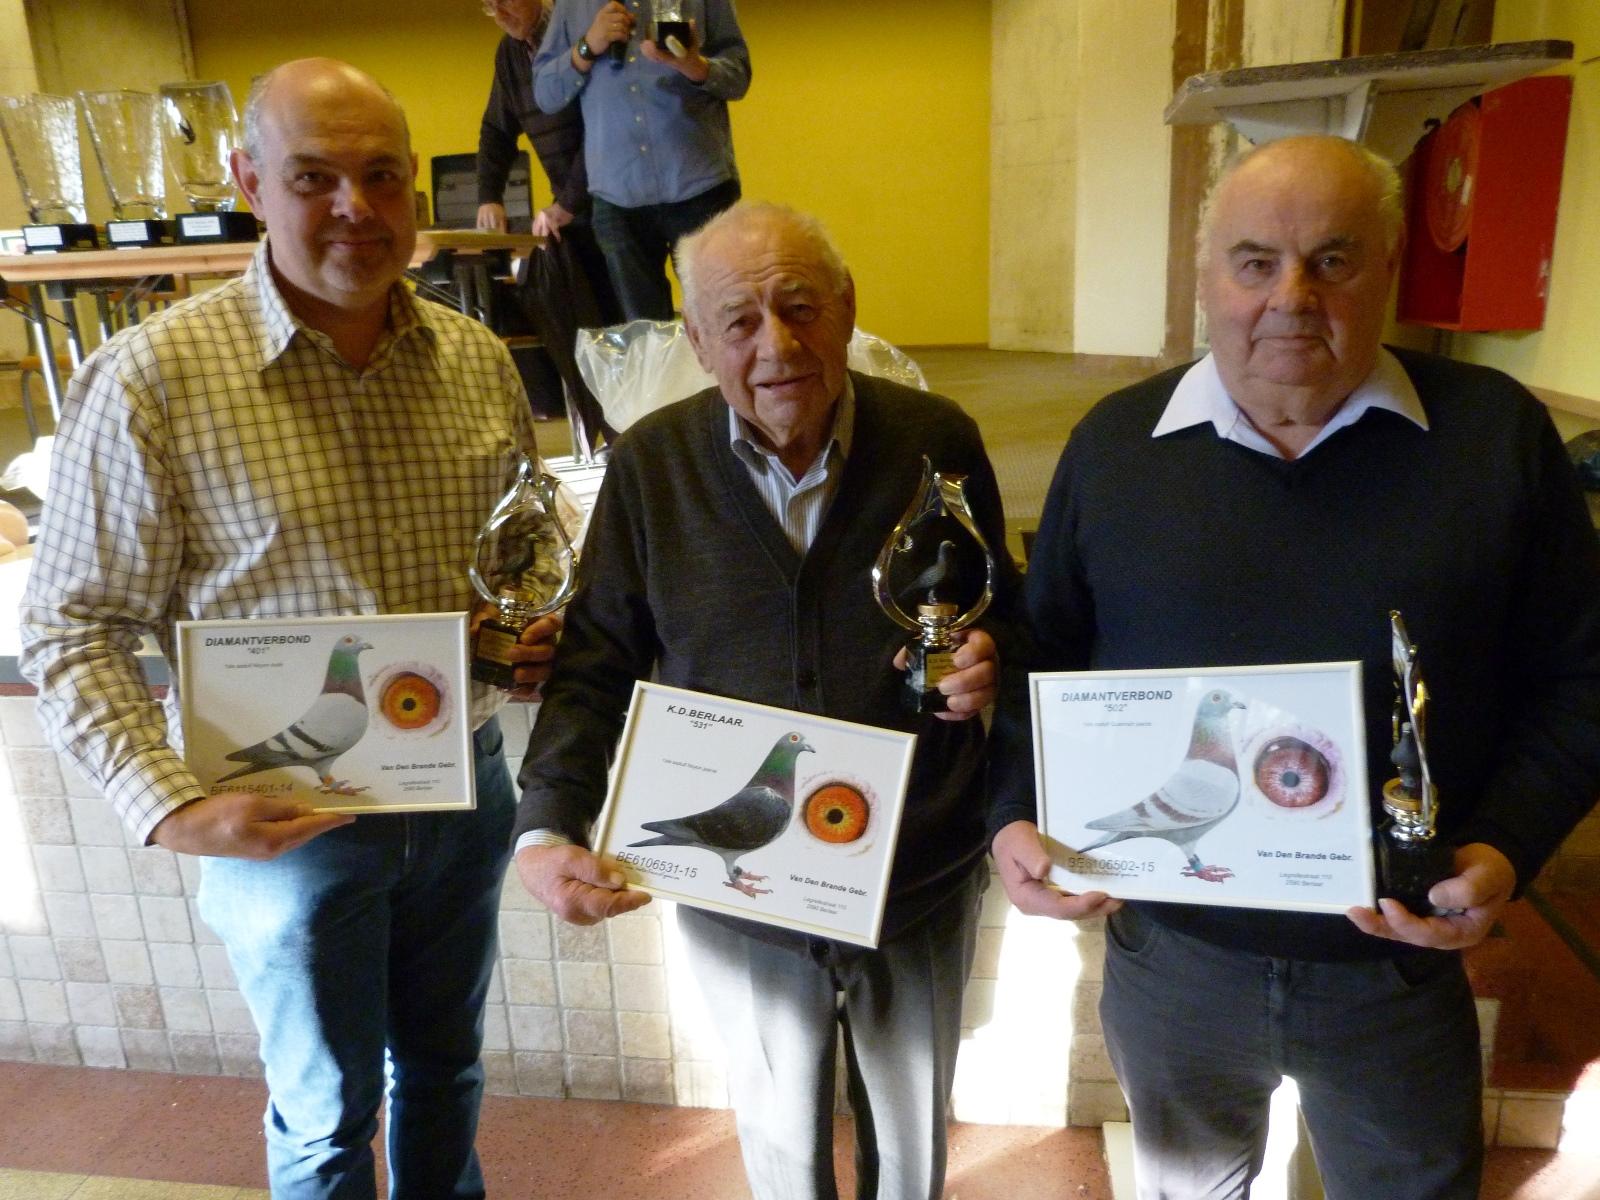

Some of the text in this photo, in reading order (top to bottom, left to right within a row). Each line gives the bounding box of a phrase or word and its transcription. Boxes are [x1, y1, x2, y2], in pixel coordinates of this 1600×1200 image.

[205, 634, 312, 647] DIAMANTVERBOND
[1061, 690, 1173, 702] DIAMANTVERBOND
[666, 704, 745, 728] K.D.BERLAAR.
[1257, 849, 1273, 858] Van
[1275, 850, 1293, 858] Den
[1295, 851, 1327, 860] Brande
[615, 851, 698, 878] BE6106531-15
[790, 874, 803, 883] Van
[804, 877, 819, 886] Den
[820, 880, 847, 892] Brande
